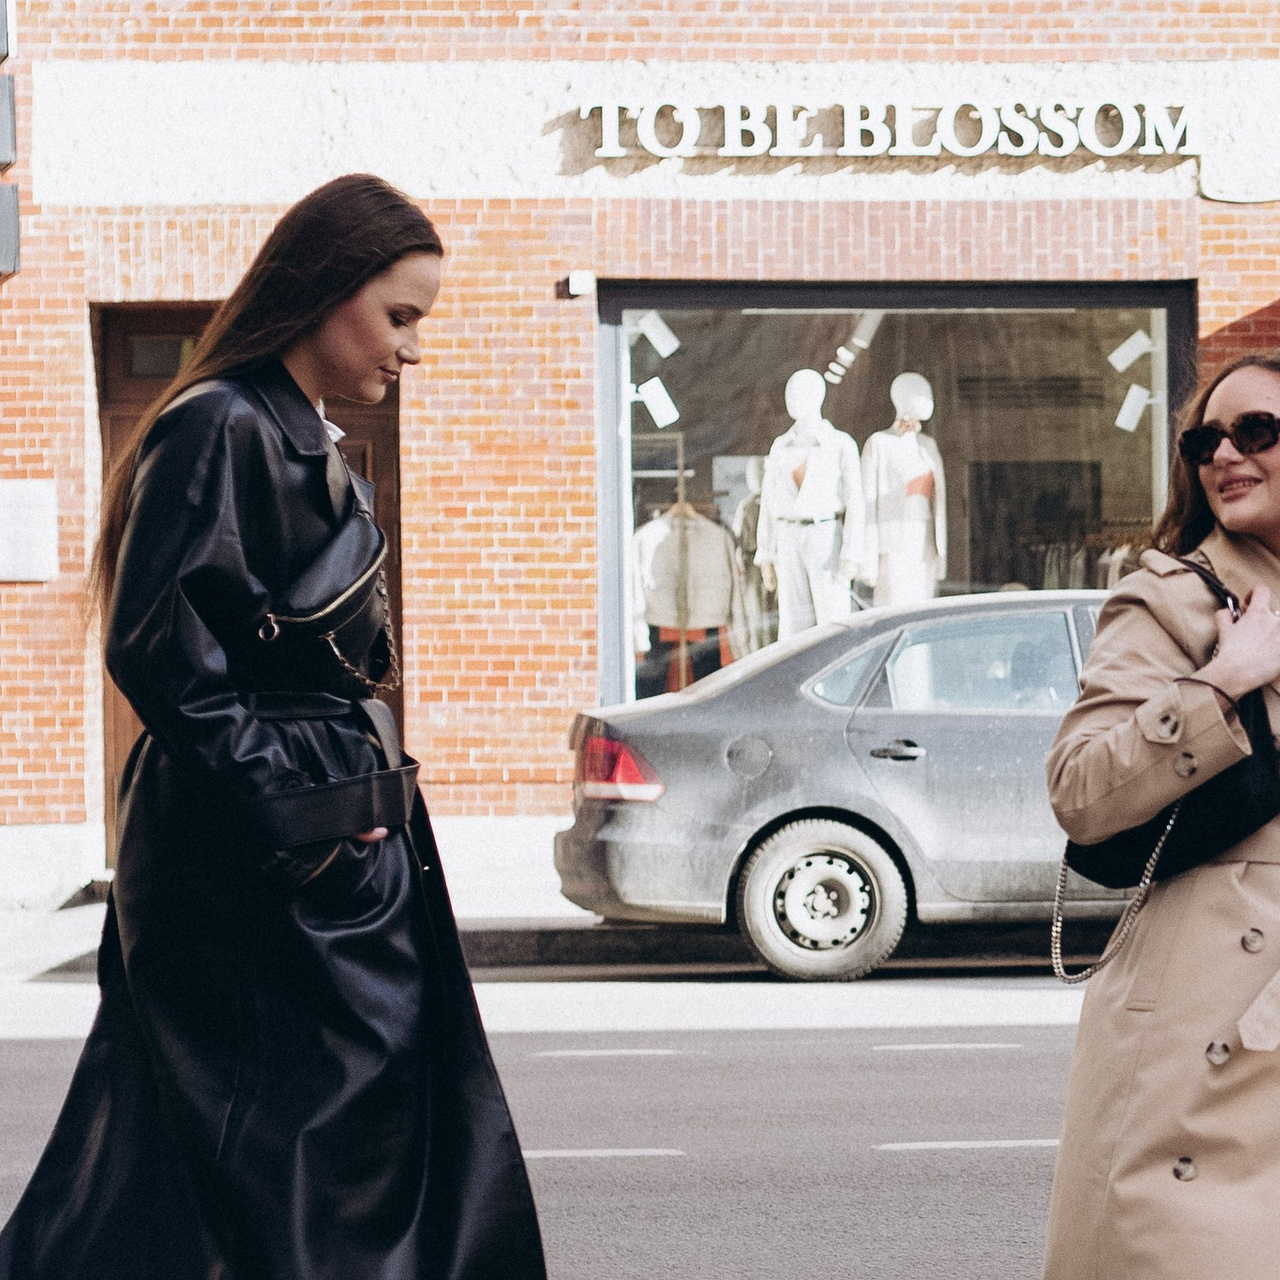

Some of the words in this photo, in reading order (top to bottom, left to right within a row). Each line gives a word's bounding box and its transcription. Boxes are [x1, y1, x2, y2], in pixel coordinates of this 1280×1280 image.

[580, 102, 700, 158] TO
[716, 102, 824, 158] BE
[836, 102, 1202, 158] BLOSSOM
